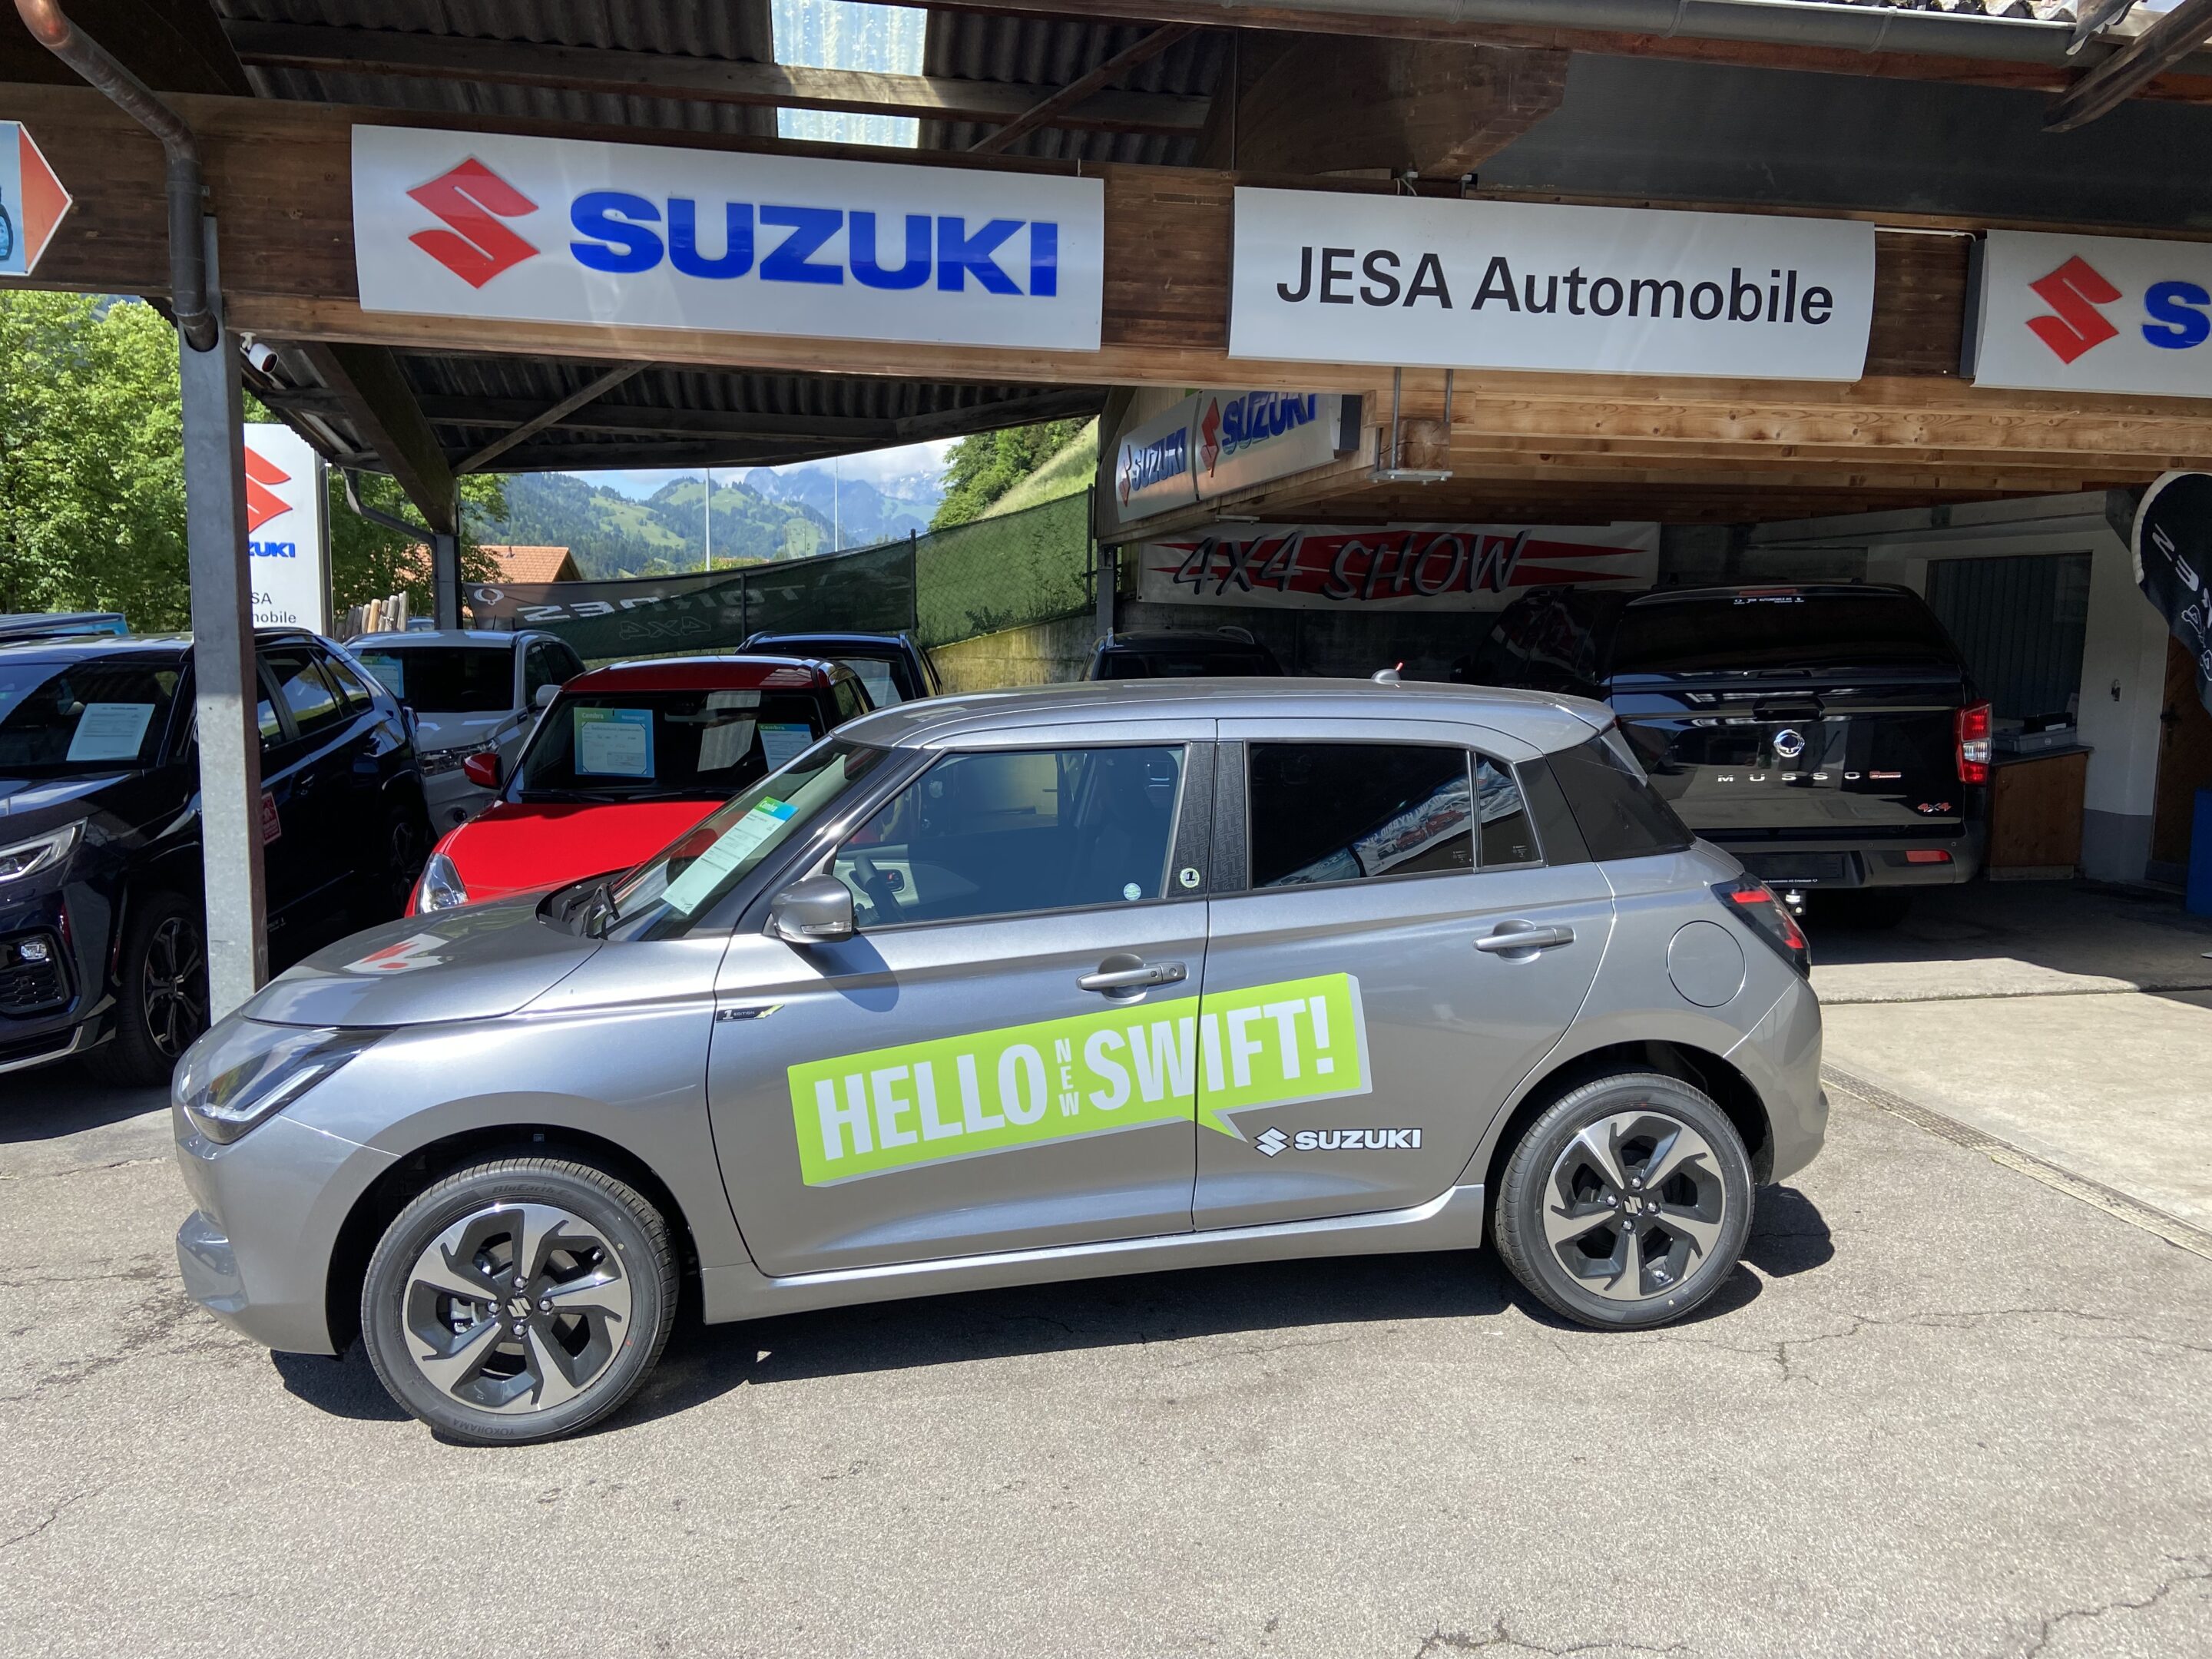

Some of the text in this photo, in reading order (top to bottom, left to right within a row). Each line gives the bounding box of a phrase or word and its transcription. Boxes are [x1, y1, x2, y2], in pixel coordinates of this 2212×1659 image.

[570, 189, 1058, 297] SUZUKI
[1277, 246, 1834, 326] JESA Automobile
[1131, 426, 1187, 484] SUZUKI
[1222, 391, 1316, 455] SUZUKI
[1174, 528, 1532, 601] 4X4 SHOW
[1717, 771, 1861, 783] MUSSO
[1185, 871, 1195, 881] 1
[813, 995, 1335, 1161] HELLO NEW SWIFT!
[1293, 1128, 1422, 1151] SUZUKI
